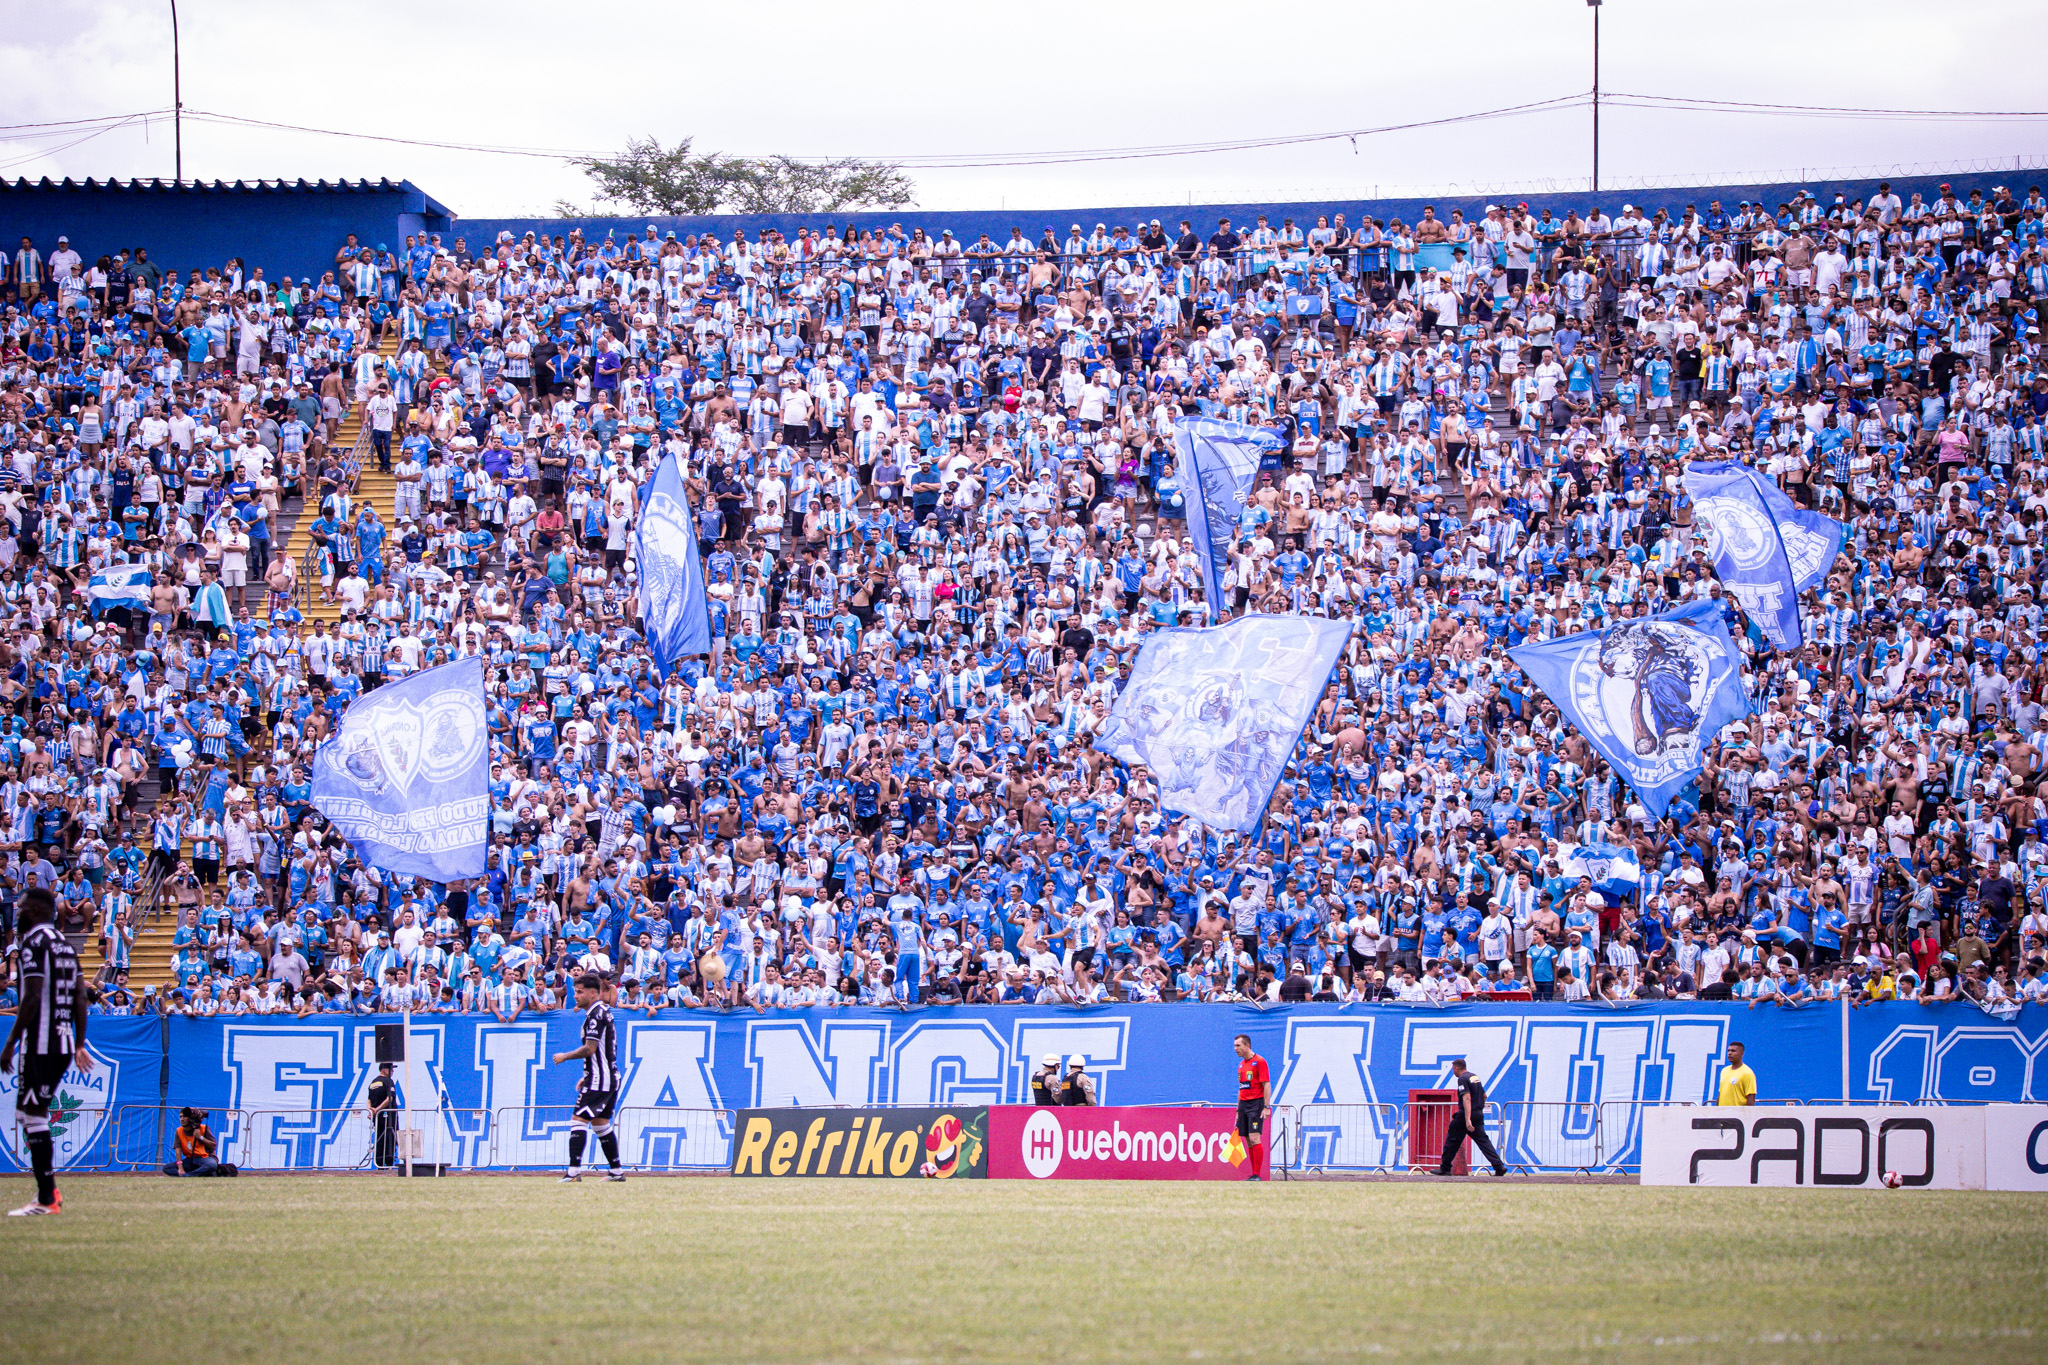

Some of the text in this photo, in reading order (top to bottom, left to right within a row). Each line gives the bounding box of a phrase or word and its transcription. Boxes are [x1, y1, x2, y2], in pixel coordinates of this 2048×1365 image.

[1756, 271, 1768, 282] 71
[0, 1070, 103, 1094] LORINA
[734, 1116, 918, 1176] Refriko
[1068, 1120, 1230, 1163] webmotors
[1689, 1117, 1935, 1186] PADO
